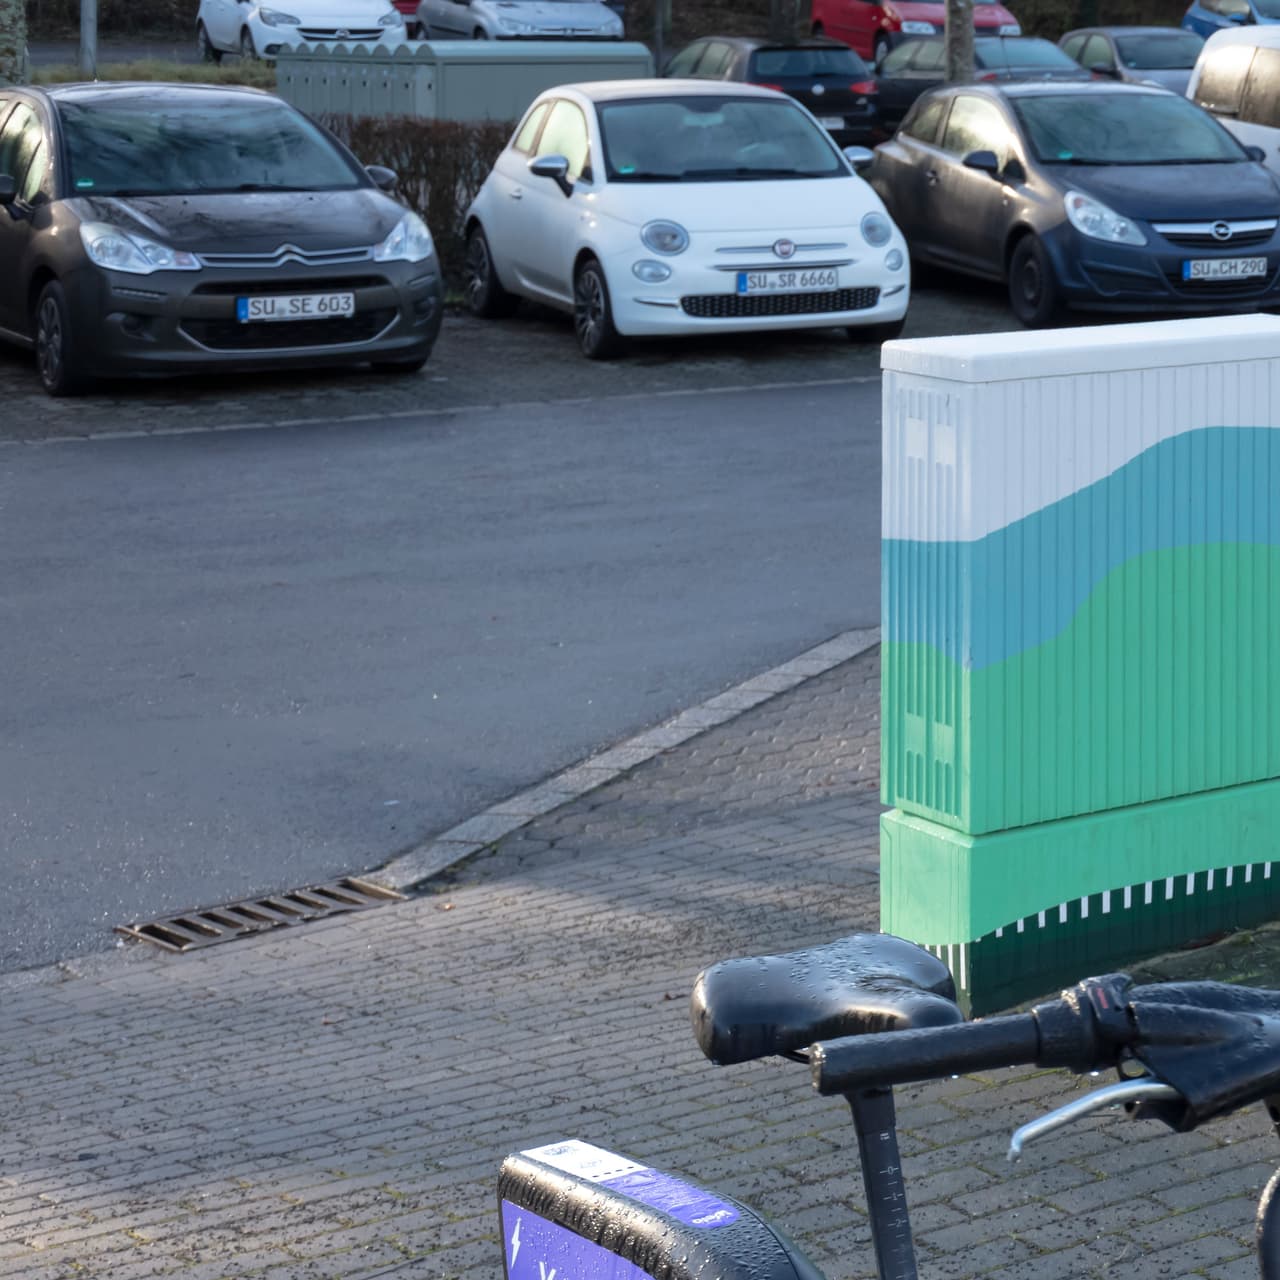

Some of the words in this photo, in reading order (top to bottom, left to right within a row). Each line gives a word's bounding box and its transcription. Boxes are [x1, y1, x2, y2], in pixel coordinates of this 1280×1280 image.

[1192, 262, 1211, 276] SU
[1220, 261, 1238, 274] CH
[1241, 259, 1266, 274] 290
[748, 274, 768, 289] SU
[778, 272, 797, 288] SR
[800, 271, 835, 287] 6666
[250, 298, 276, 316] SU
[289, 297, 313, 314] SE
[318, 295, 352, 313] 603
